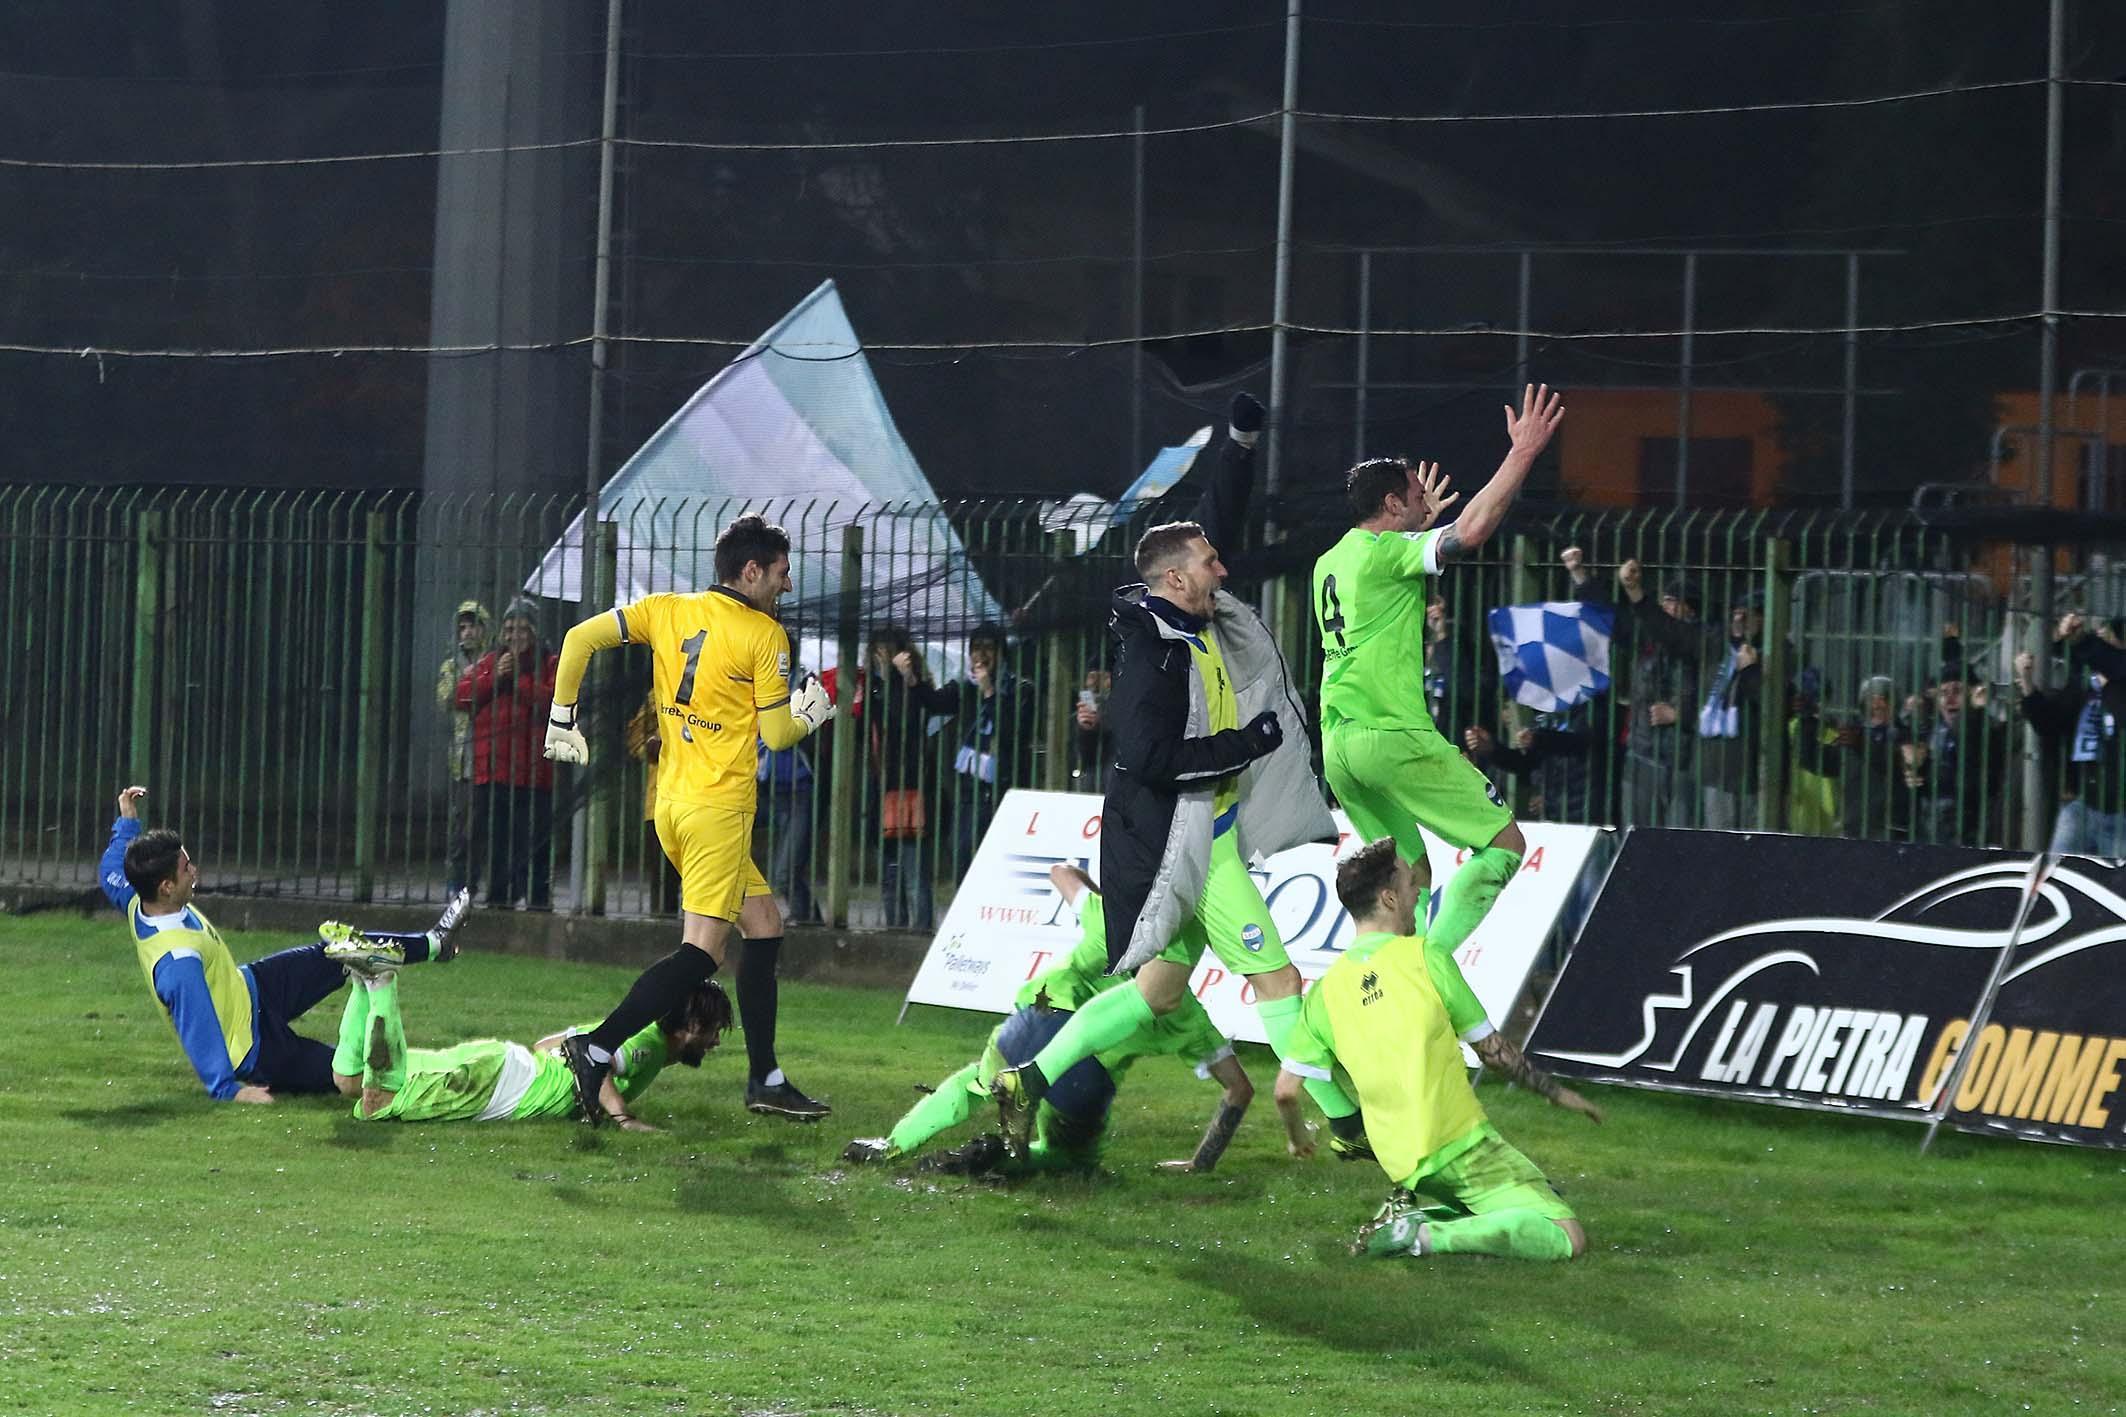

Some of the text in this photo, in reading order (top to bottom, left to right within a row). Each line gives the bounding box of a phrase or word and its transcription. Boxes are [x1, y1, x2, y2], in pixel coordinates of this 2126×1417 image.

[1321, 573, 1346, 648] 4
[674, 628, 710, 706] 1
[687, 713, 722, 733] Group
[1700, 1000, 2126, 1130] LA PIETRA GOMME
